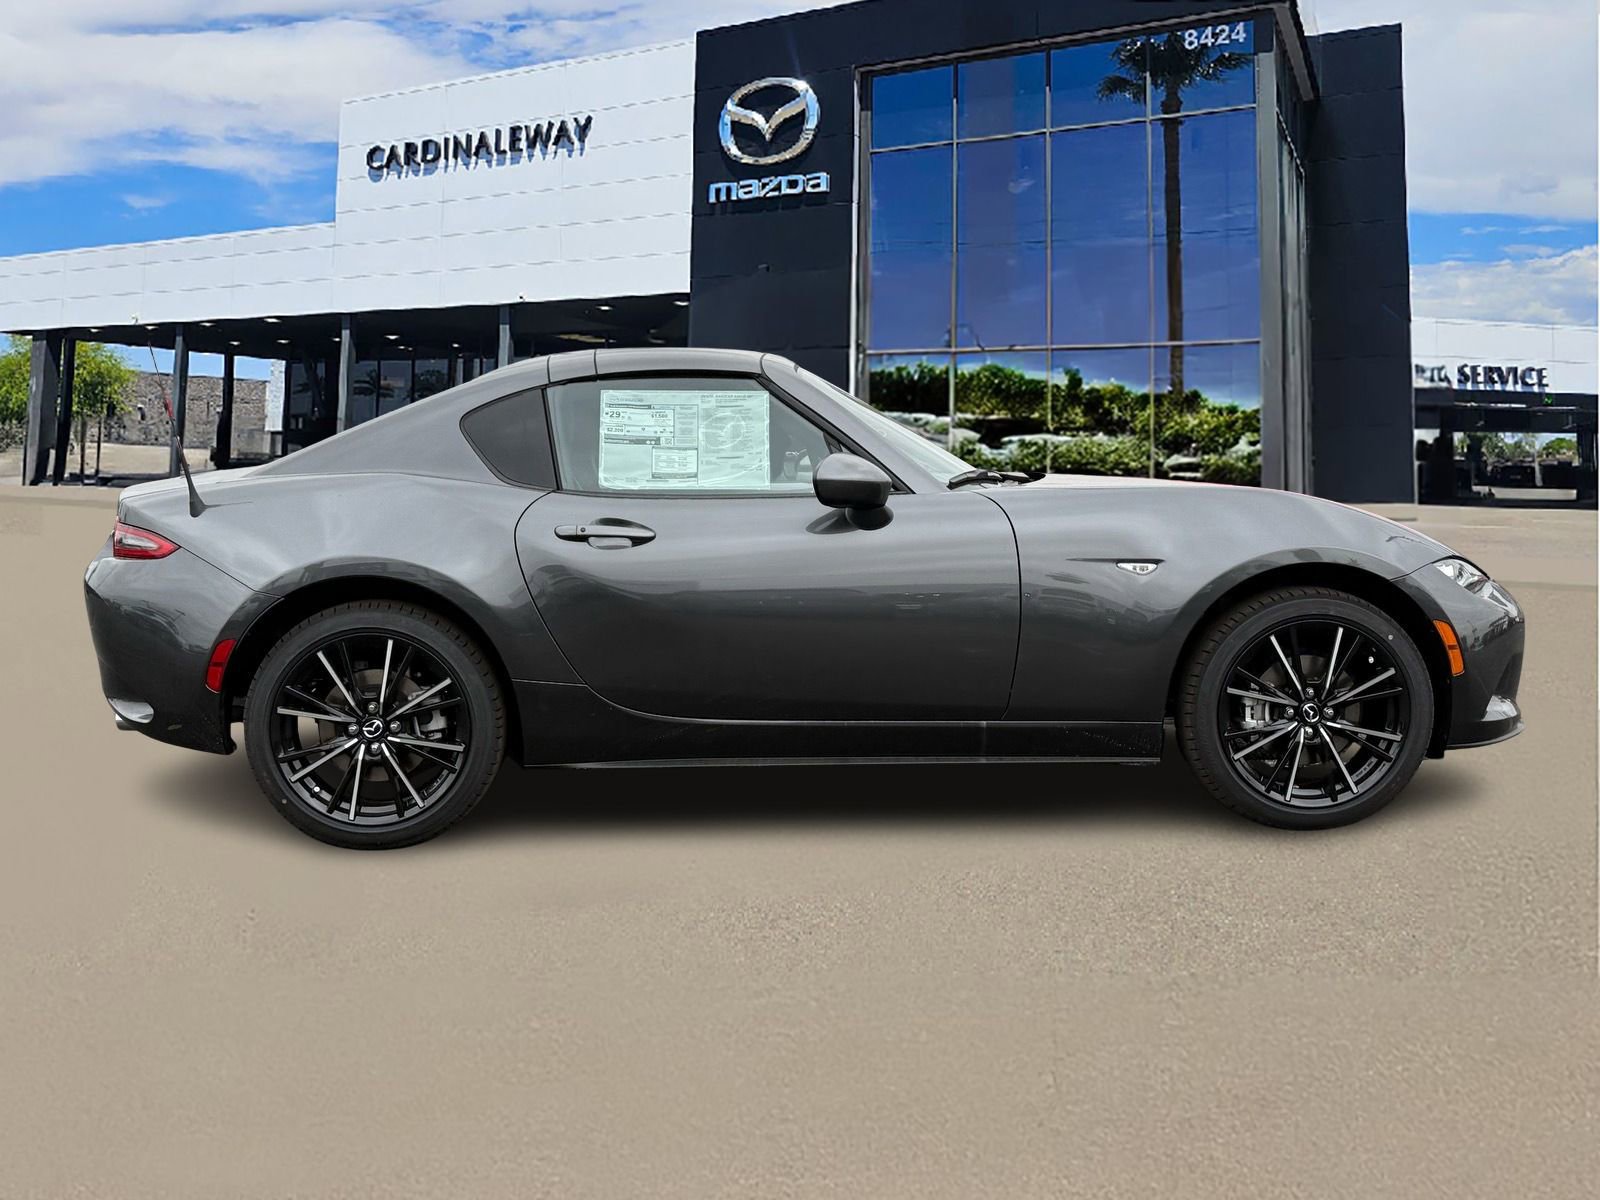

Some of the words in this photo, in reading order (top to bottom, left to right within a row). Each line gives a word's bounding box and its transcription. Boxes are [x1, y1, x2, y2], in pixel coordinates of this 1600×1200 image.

[1184, 22, 1246, 50] 8424
[366, 115, 593, 170] CARDINALEWAY
[1457, 363, 1549, 387] SERVICE
